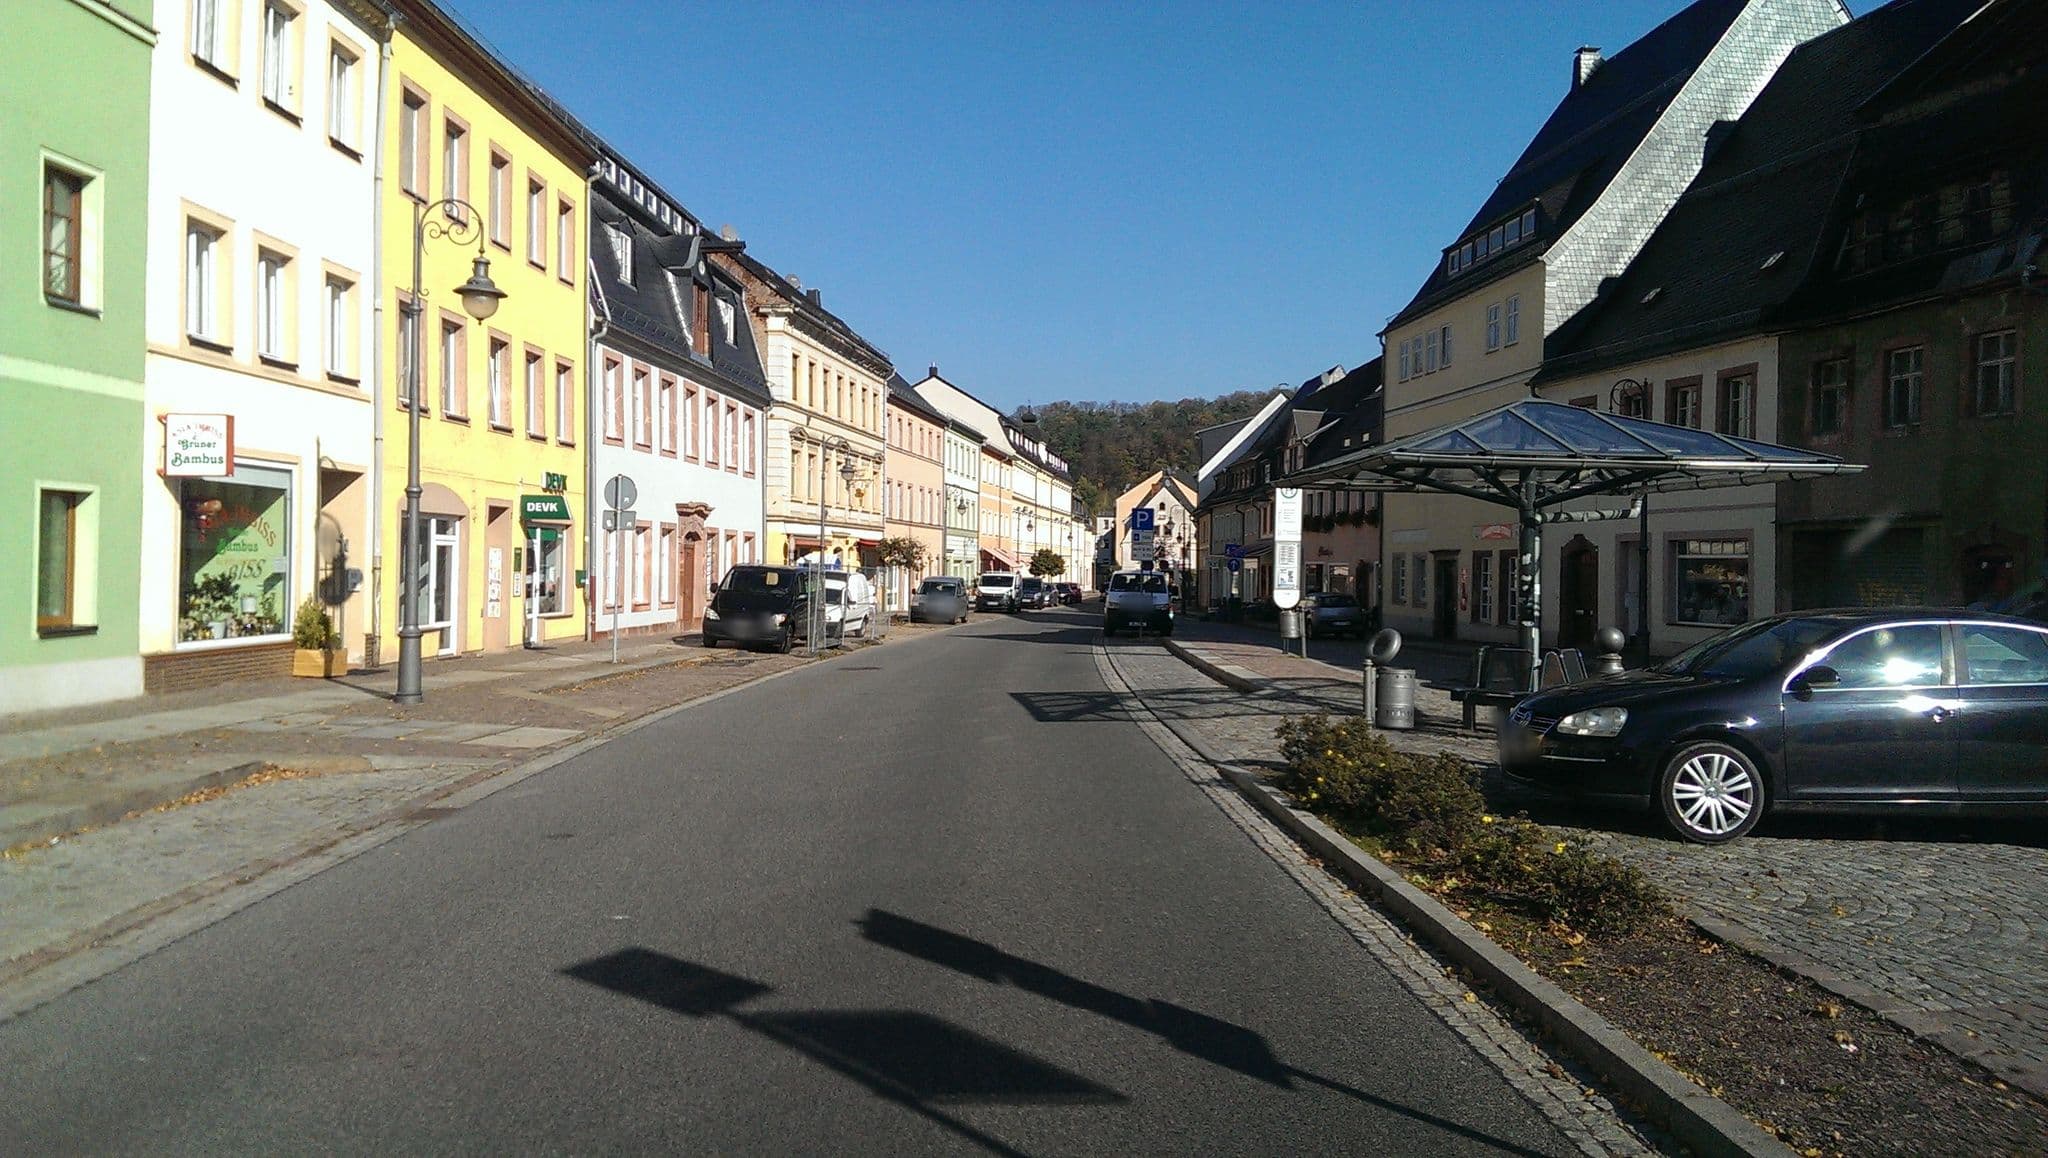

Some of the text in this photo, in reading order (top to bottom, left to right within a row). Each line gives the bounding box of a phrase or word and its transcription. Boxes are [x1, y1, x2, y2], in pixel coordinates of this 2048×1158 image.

[171, 452, 224, 467] Bambus
[545, 471, 568, 491] DEVK
[526, 502, 558, 512] DEVK
[1136, 510, 1150, 529] P
[216, 538, 259, 555] Bambus
